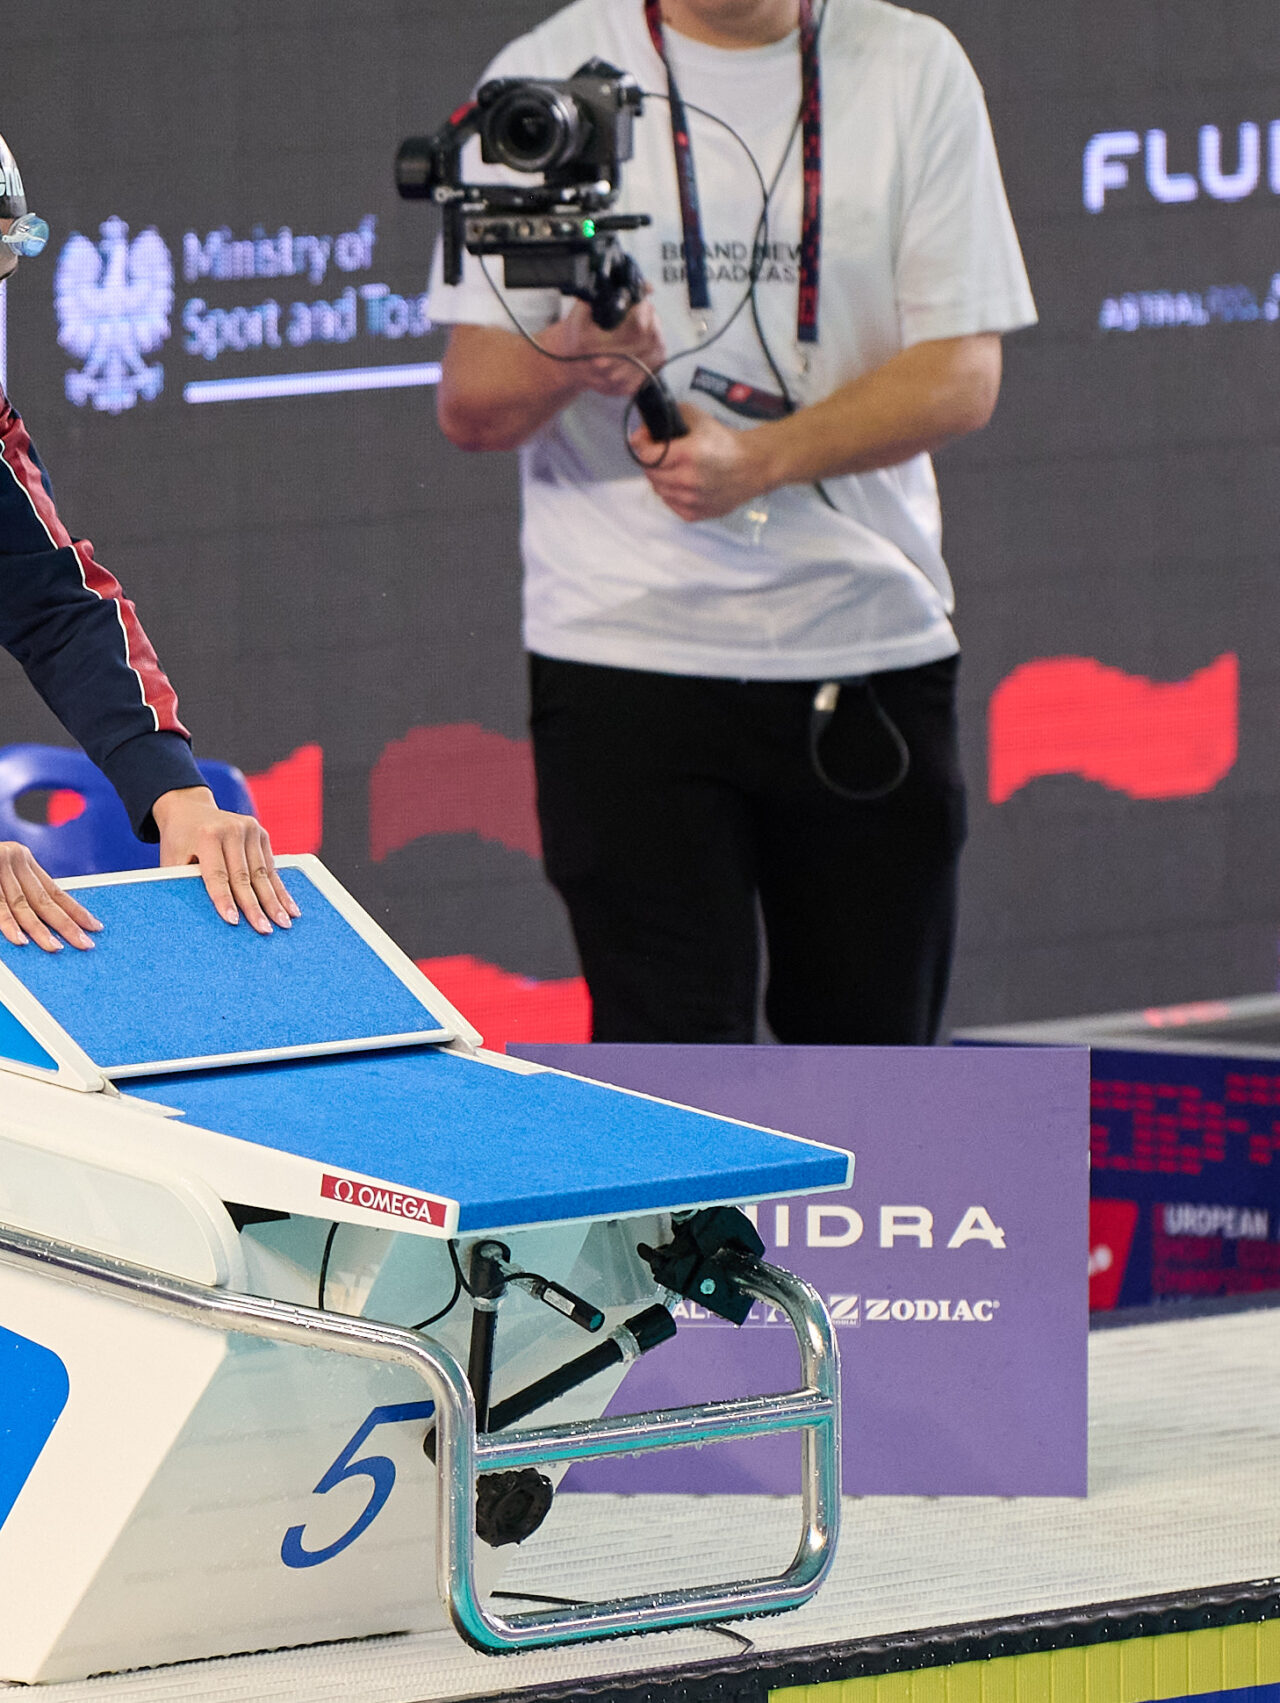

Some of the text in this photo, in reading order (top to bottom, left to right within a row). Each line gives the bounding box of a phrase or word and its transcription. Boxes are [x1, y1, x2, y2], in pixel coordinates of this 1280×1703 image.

[334, 214, 377, 272] of
[183, 297, 282, 361] Sport
[286, 286, 358, 347] and
[358, 1186, 432, 1223] OMEGA
[745, 1204, 1006, 1248] IDRA
[280, 1399, 436, 1569] 5
